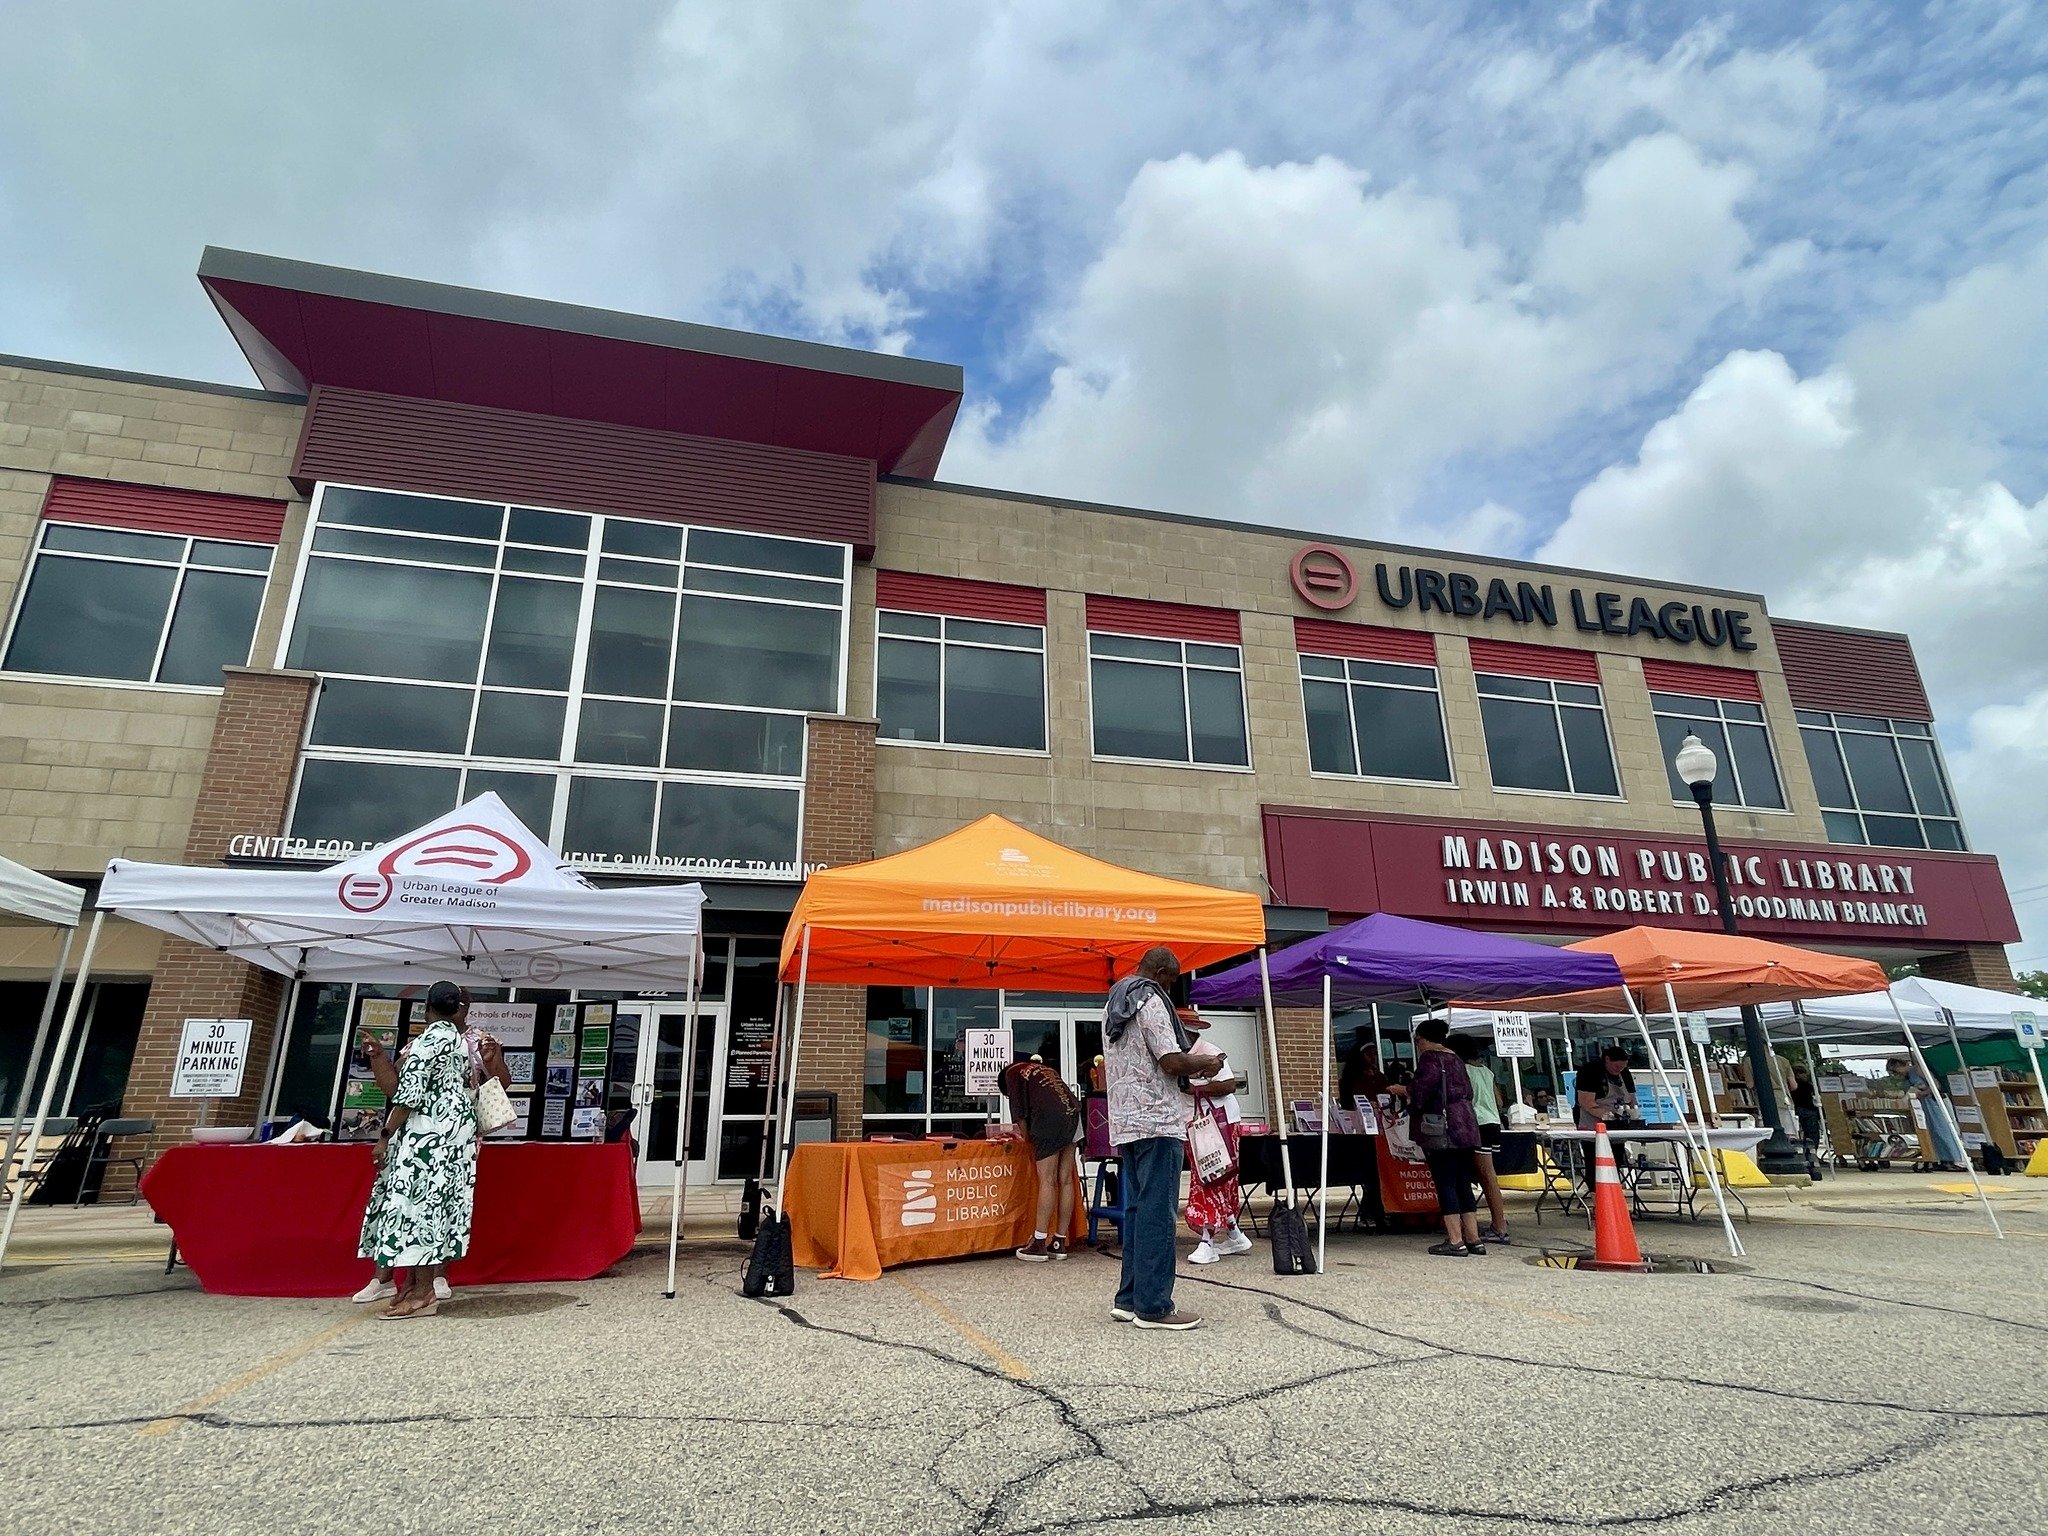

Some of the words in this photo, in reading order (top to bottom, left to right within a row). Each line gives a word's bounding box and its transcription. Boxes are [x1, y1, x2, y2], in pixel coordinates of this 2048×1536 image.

[1374, 563, 1558, 625] URBAN
[1570, 588, 1758, 650] LEAGUE
[229, 834, 308, 858] CENTER
[314, 839, 354, 861] FOR
[631, 854, 741, 879] WORKFORCE
[1442, 835, 1620, 877] MADISON
[1636, 848, 1766, 886] PUBIC
[1779, 858, 1915, 894] LIBRARY
[402, 880, 437, 893] Urban
[441, 882, 480, 898] League
[486, 885, 499, 896] of
[400, 893, 443, 905] Greater
[446, 897, 496, 909] Madison
[1446, 878, 1529, 907] IRWIN
[1591, 886, 1684, 914] ROBERT
[1692, 892, 1718, 916] D.
[1838, 901, 1928, 927] BRANCH
[922, 896, 1157, 924] madisonpubliclibrary.org
[469, 1010, 499, 1018] Schools
[501, 1010, 510, 1018] of
[511, 1011, 533, 1019] Hope
[1497, 1015, 1524, 1026] MINUTE
[208, 1025, 225, 1039] 30
[983, 1033, 995, 1046] 30
[1497, 1027, 1528, 1038] PARKING
[190, 1041, 237, 1055] MINUTE
[973, 1047, 1006, 1059] MINUTE
[181, 1057, 239, 1071] PARKING
[946, 1164, 1013, 1182] MADISON
[1400, 1170, 1432, 1178] MADISO
[946, 1184, 998, 1201] PUBLIC
[1405, 1181, 1436, 1189] PUBLIC
[1403, 1192, 1439, 1201] LIBRARY
[946, 1203, 1008, 1222] LIBRARY
